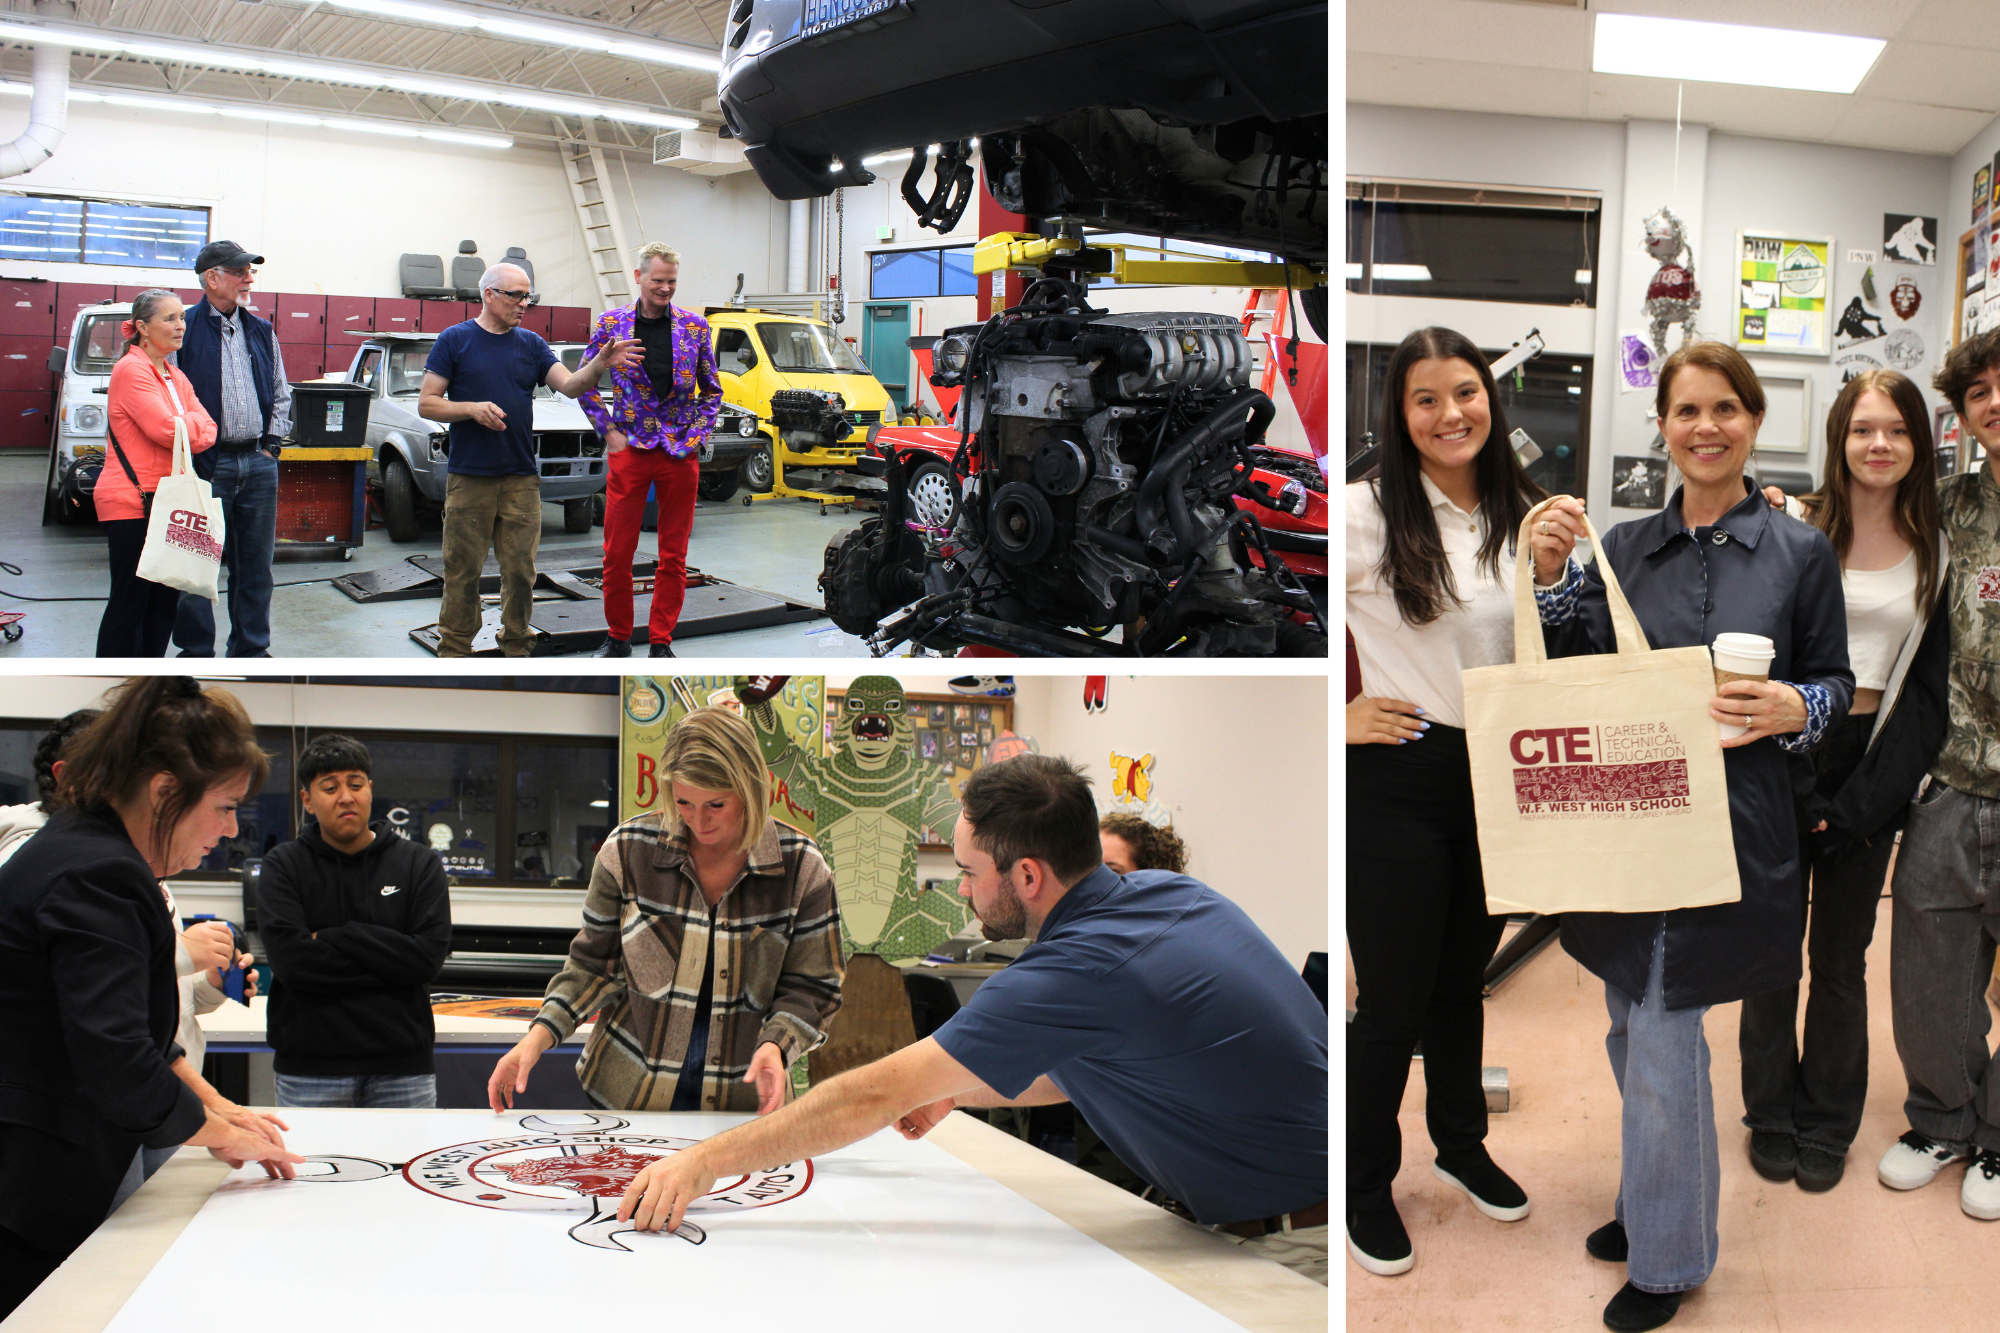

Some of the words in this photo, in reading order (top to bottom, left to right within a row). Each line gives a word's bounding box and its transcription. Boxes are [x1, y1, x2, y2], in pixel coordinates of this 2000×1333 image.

[801, 1, 889, 39] MOTORSPORT
[1849, 252, 1875, 262] PNW
[169, 509, 208, 532] CTE
[178, 542, 194, 553] WEST
[195, 548, 212, 559] HIGH
[1604, 723, 1656, 738] CAREER
[1658, 721, 1669, 733] &
[1509, 726, 1594, 766] CTE
[1605, 733, 1681, 750] TECHNICAL
[1606, 745, 1686, 763] EDUCATION
[1518, 803, 1545, 814] W.F.
[1548, 802, 1586, 813] WEST
[1590, 801, 1626, 812] HIGH
[1630, 797, 1691, 811] SCHOOL
[1519, 814, 1559, 822] PREPARING
[1560, 812, 1595, 820] STUDENTS
[1597, 812, 1612, 820] FOR
[1613, 812, 1627, 820] THE
[1629, 810, 1664, 820] JOURNEY
[1665, 807, 1692, 816] AHEAD
[422, 1149, 478, 1170] WEST
[478, 1137, 561, 1152] AUTO
[573, 1136, 670, 1144] SHOP
[742, 1174, 795, 1200] AUTO
